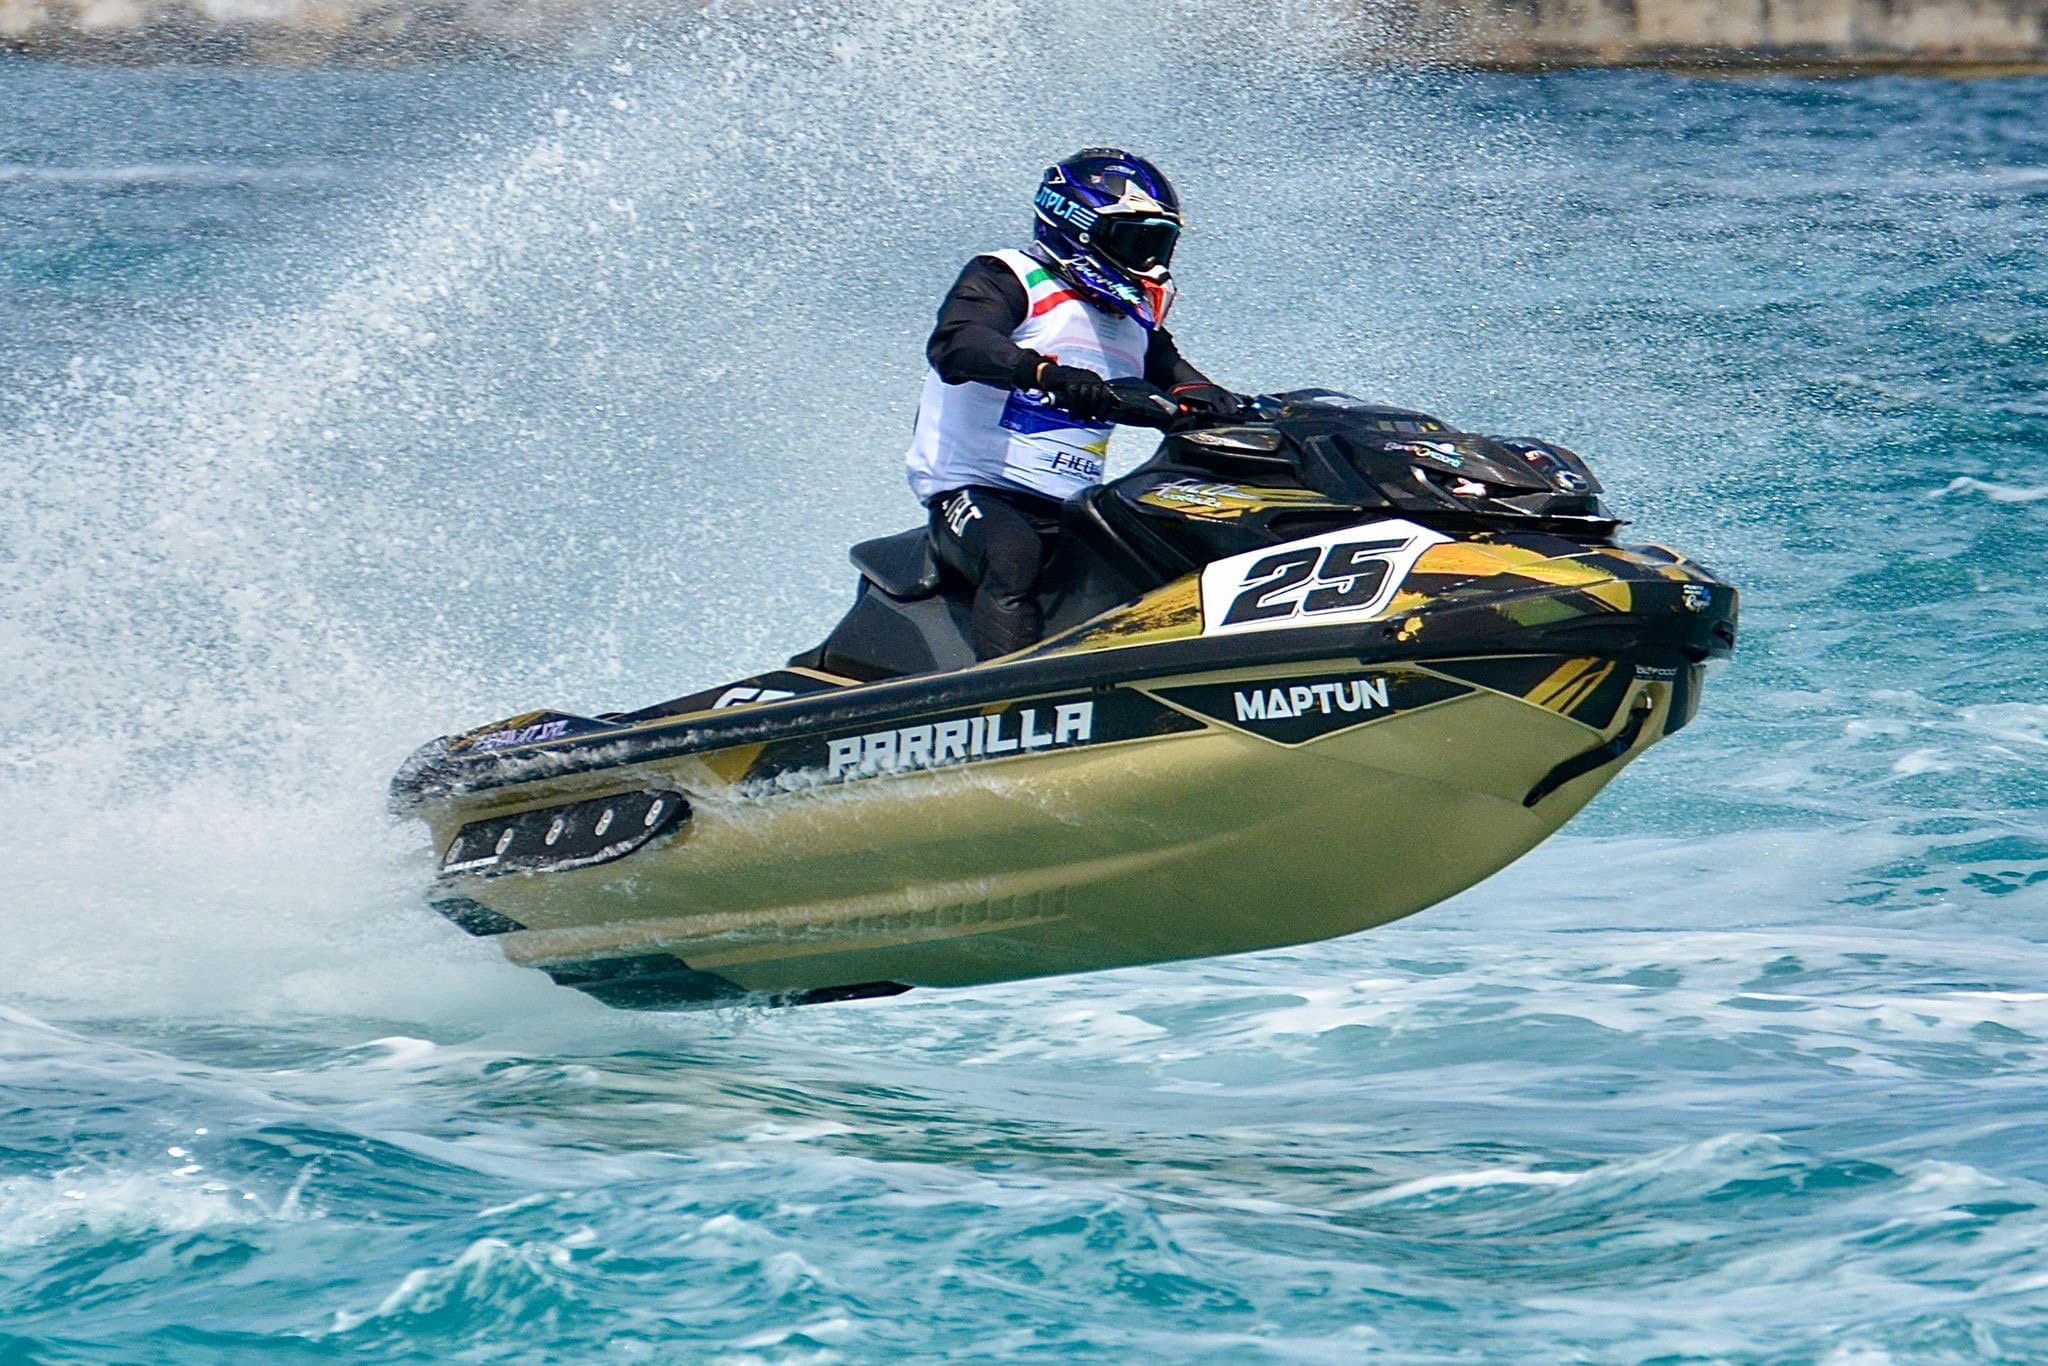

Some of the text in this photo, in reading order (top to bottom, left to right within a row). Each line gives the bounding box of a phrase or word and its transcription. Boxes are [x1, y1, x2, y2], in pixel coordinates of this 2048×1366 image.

[1220, 536, 1417, 626] 25
[827, 700, 1094, 777] PARRILLA
[1235, 678, 1389, 722] MAPTUN
